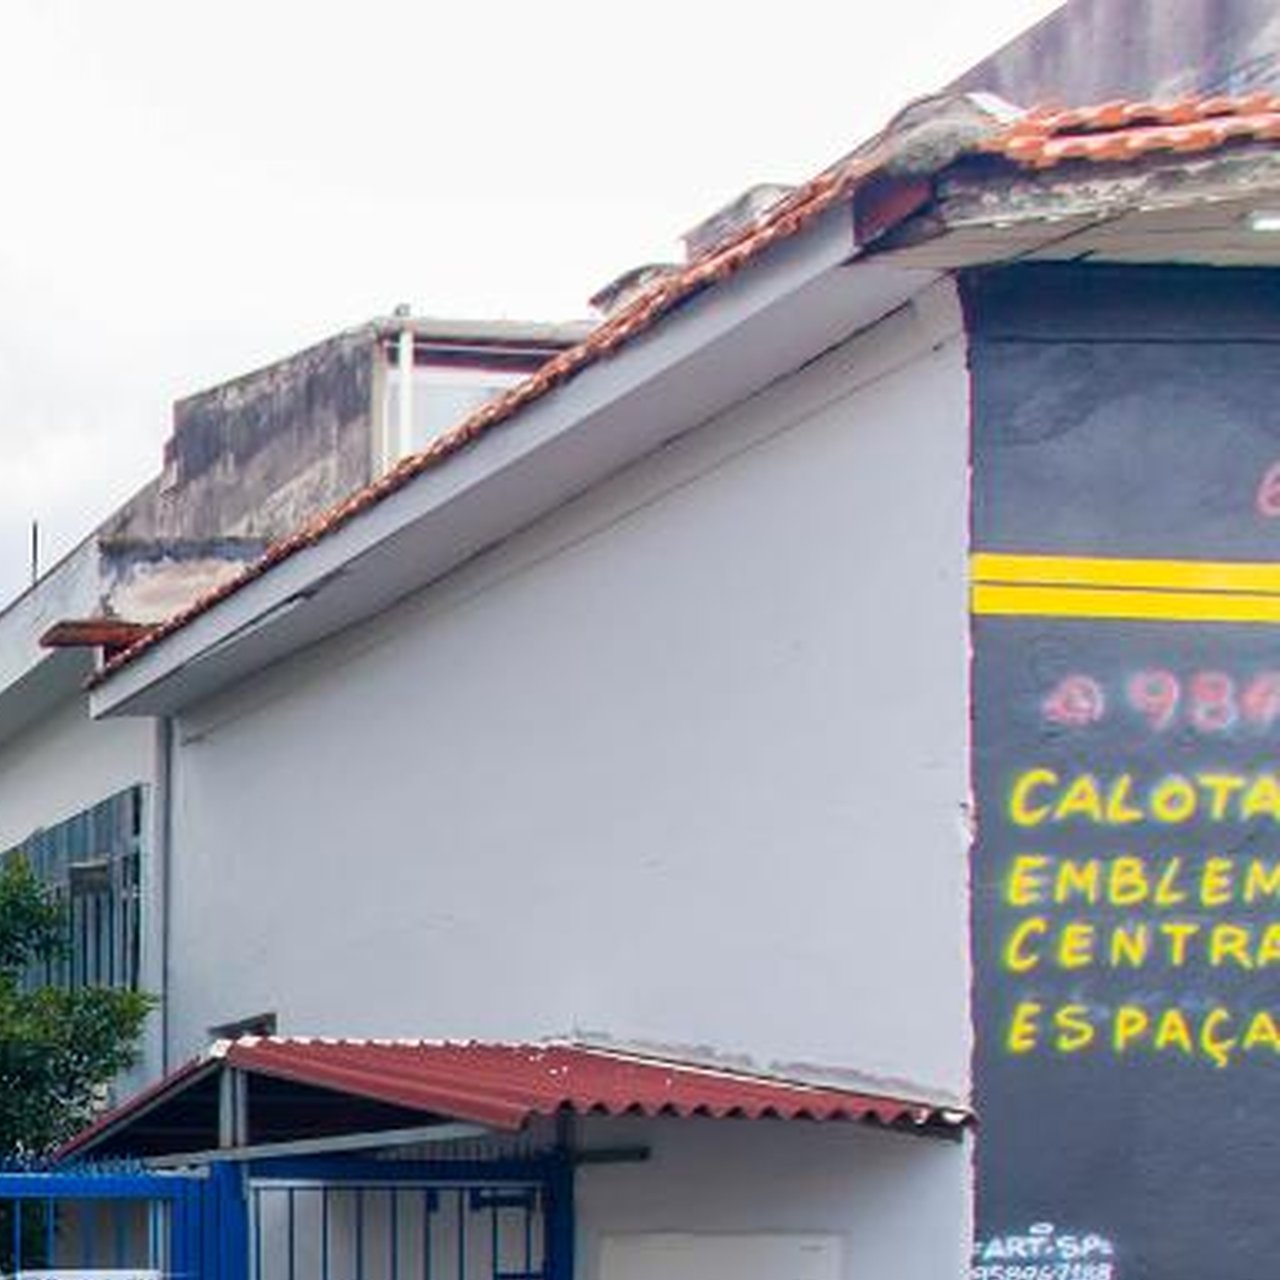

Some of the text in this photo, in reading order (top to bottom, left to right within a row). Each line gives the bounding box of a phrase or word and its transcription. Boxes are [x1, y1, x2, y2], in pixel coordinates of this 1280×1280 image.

[1009, 769, 1280, 826] CALOTA
[1007, 855, 1280, 907] EMBLEM
[1006, 1000, 1280, 1067] ESPAÇA
